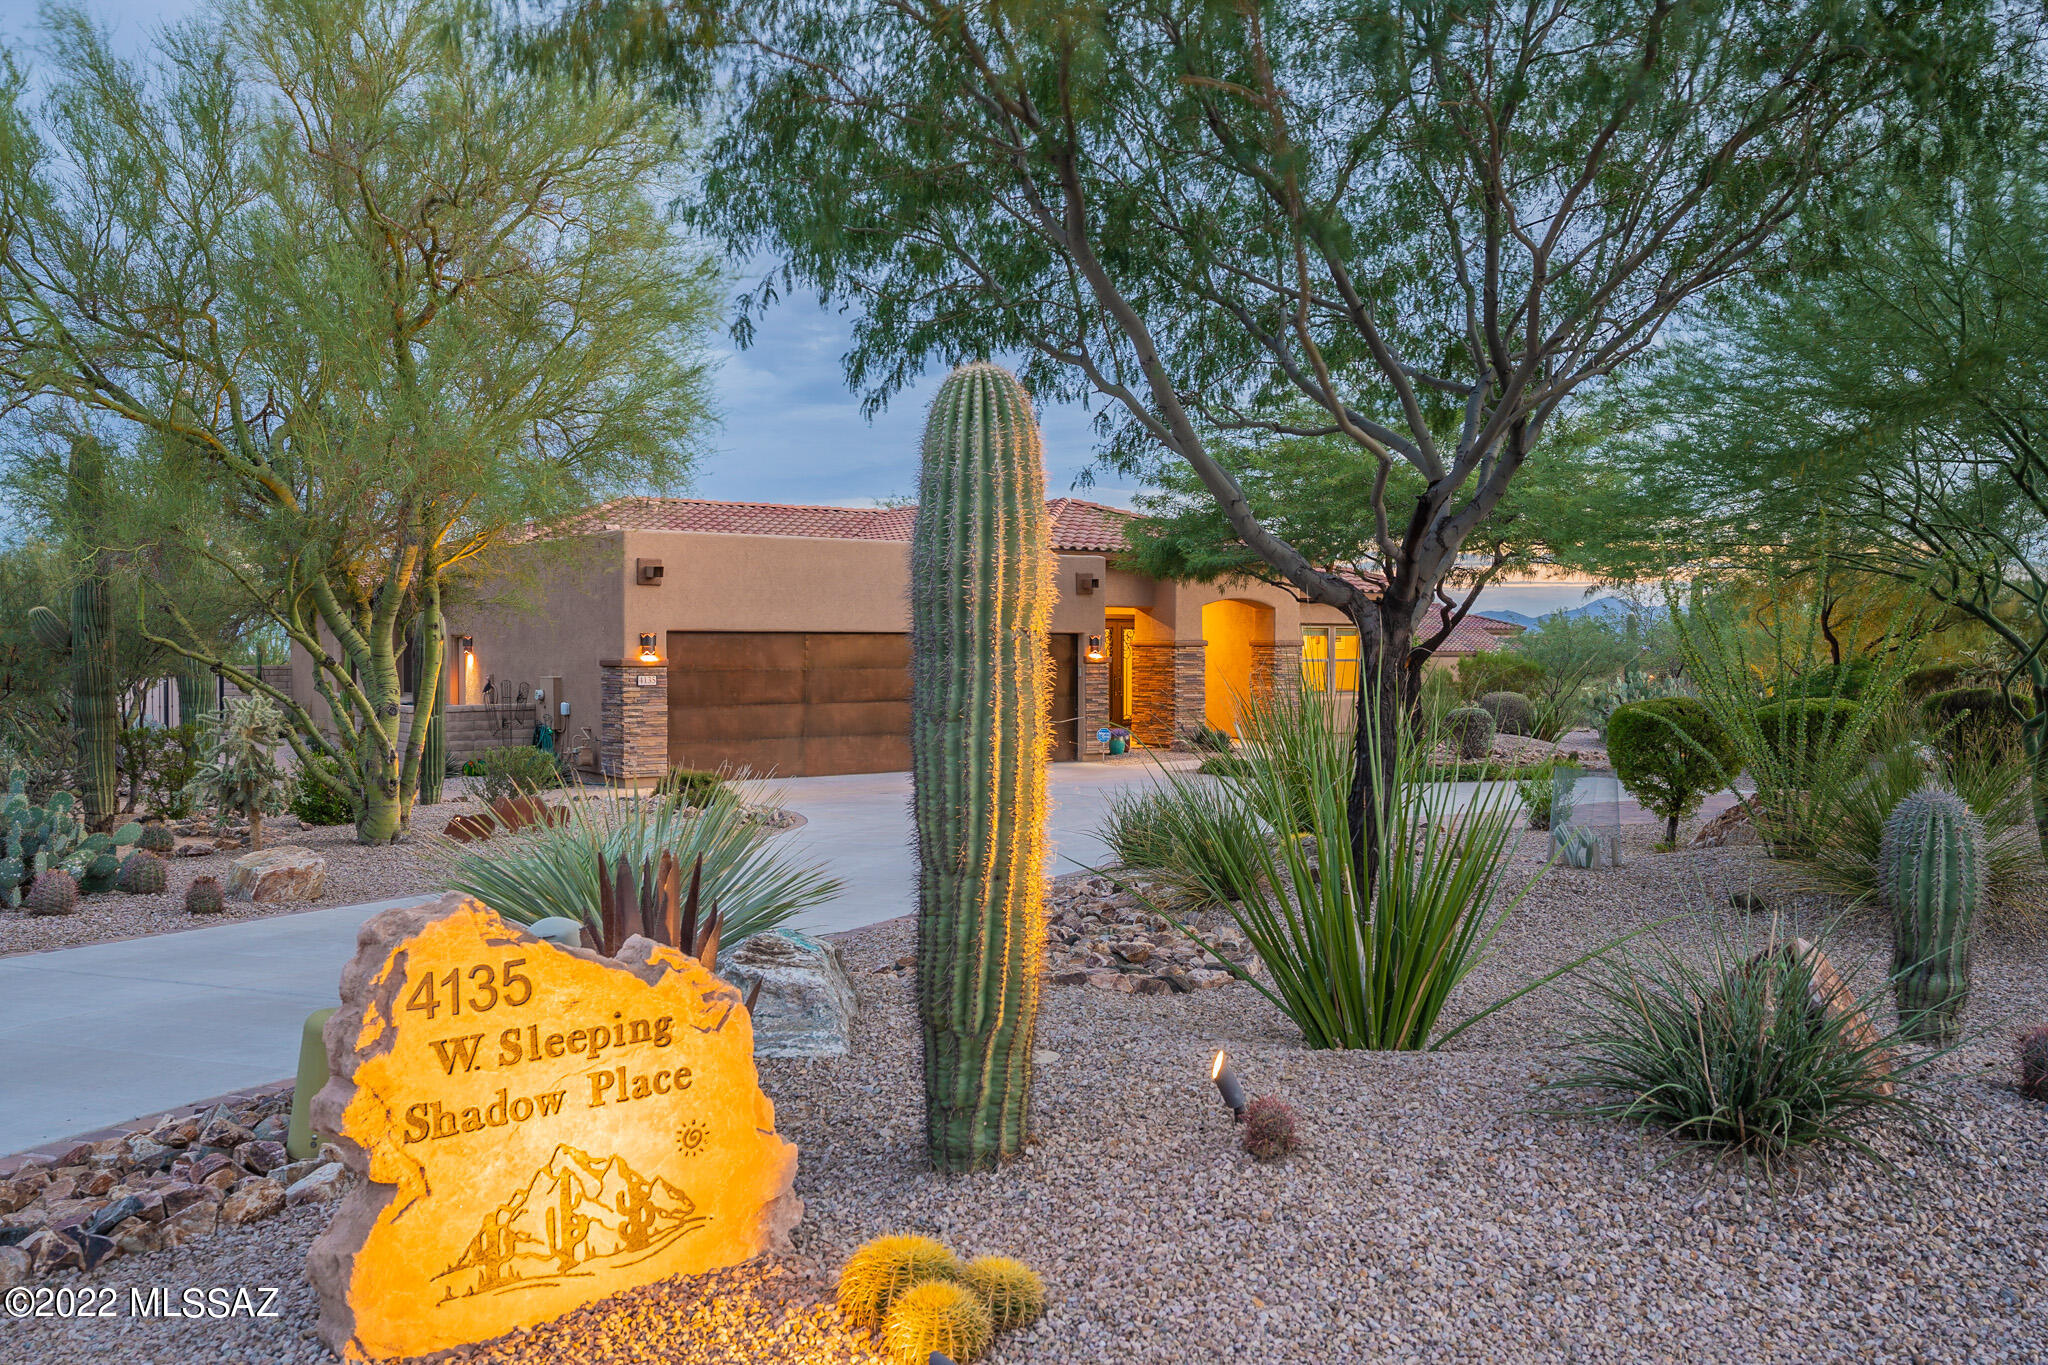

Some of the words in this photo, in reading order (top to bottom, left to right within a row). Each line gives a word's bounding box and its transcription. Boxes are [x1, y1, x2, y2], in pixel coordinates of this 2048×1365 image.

[406, 958, 533, 1020] 4135
[429, 1032, 485, 1076] W.
[498, 1012, 673, 1067] Sleeping
[403, 1088, 567, 1144] Shadow
[587, 1065, 693, 1108] Place
